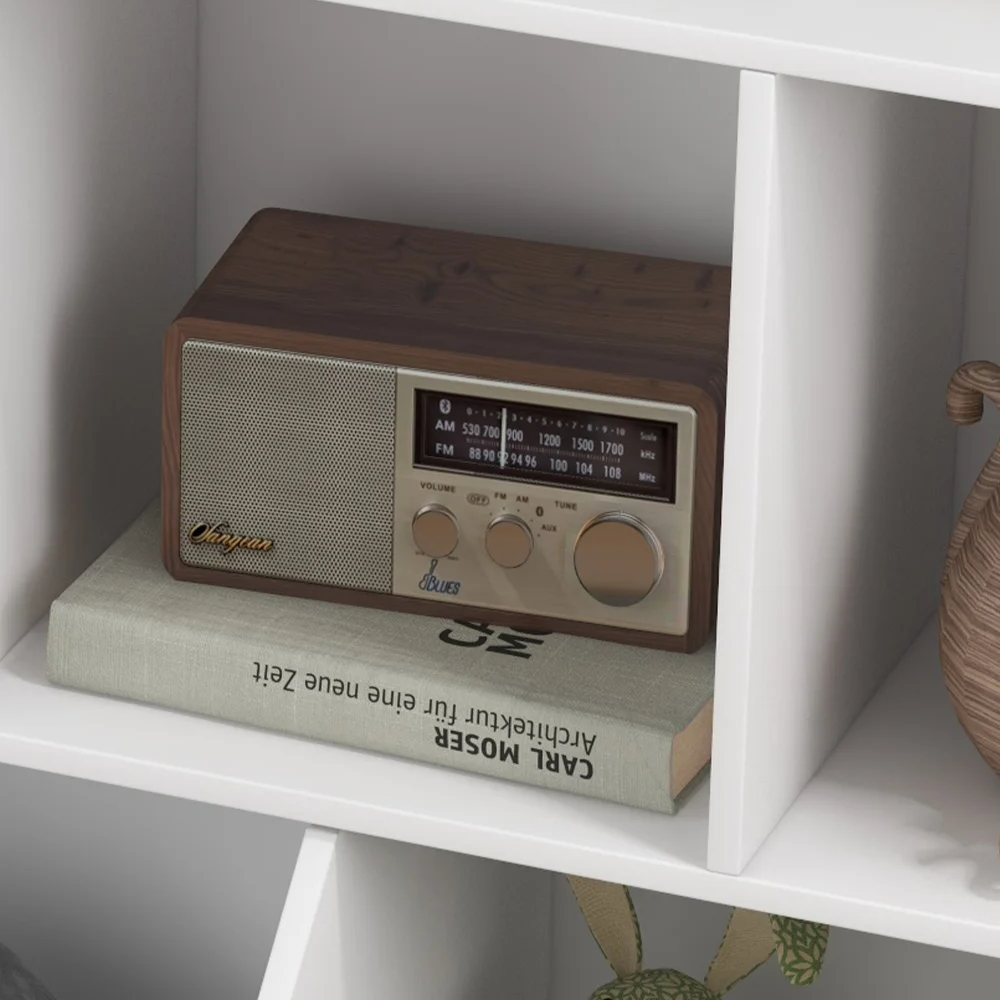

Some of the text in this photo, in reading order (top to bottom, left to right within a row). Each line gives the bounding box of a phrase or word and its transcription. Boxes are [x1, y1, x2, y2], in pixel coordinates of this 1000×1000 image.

[434, 420, 455, 432] AM
[462, 422, 480, 436] 530
[482, 425, 500, 439] 700
[506, 428, 523, 442] 900
[539, 432, 561, 448] 1200
[572, 437, 594, 452] 1500
[600, 441, 624, 456] 1700
[435, 443, 454, 456] FM
[468, 447, 481, 460] 88
[483, 449, 495, 462] 90
[511, 453, 522, 466] 94
[525, 455, 537, 468] 96
[550, 458, 568, 472] 100
[576, 461, 593, 475] 104
[604, 465, 621, 480] 108
[420, 481, 456, 494] VOLUME
[469, 495, 487, 505] OFF
[494, 491, 507, 501] FM
[515, 495, 529, 504] AM
[554, 500, 578, 511] TUNE
[541, 524, 557, 532] AUX
[253, 661, 597, 755] Architektur für eine neue Zeit
[434, 726, 593, 780] CARL MOSER
